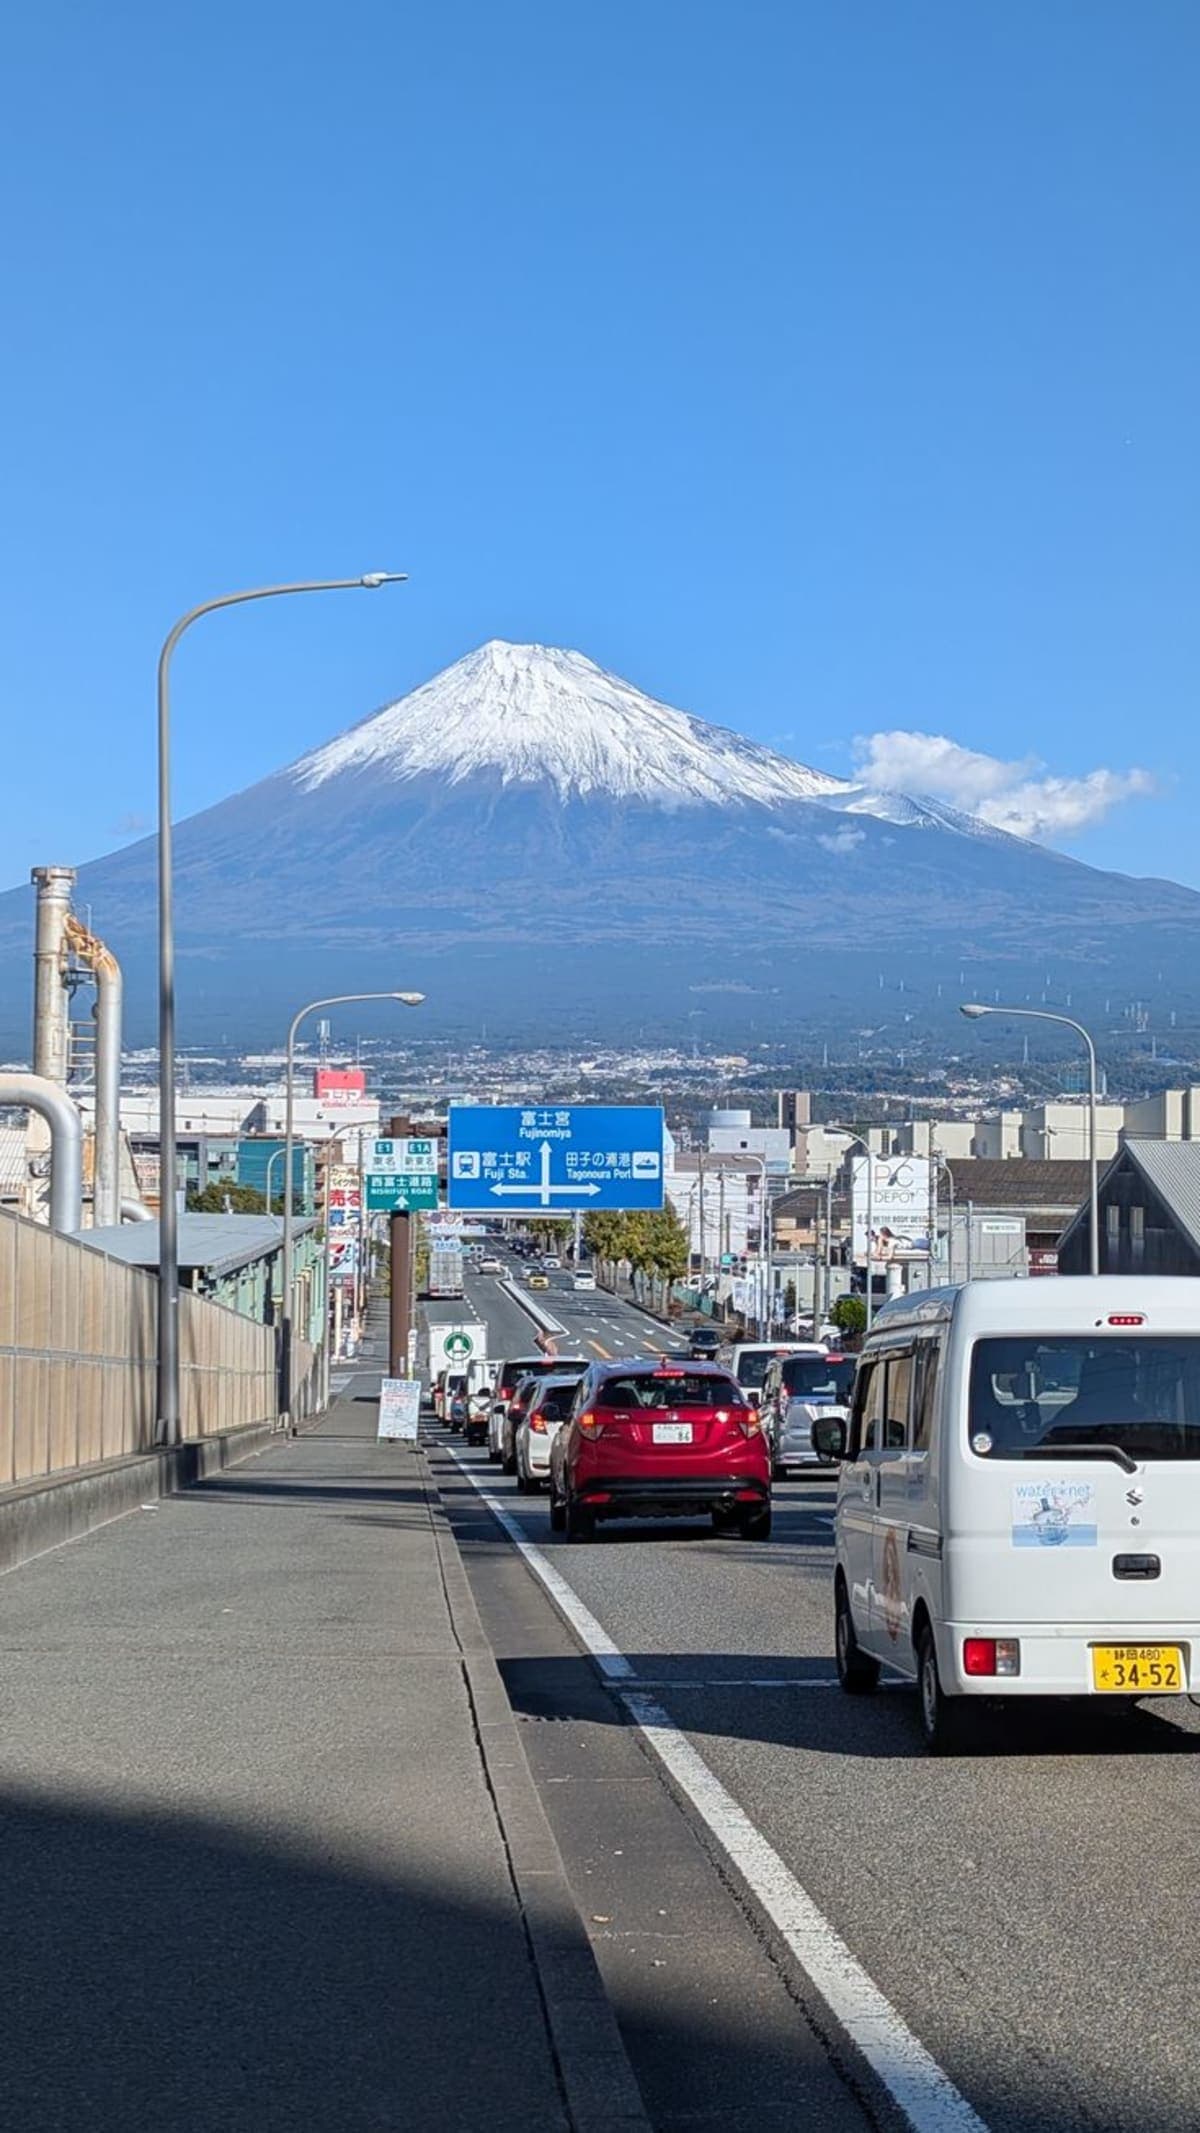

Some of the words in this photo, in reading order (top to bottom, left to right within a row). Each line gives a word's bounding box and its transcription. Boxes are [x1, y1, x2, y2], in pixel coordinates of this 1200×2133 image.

[520, 1110, 571, 1126] 富士宮
[518, 1127, 572, 1140] Fujinomiya
[377, 1143, 391, 1153] E1
[409, 1143, 430, 1153] E1A
[373, 1156, 396, 1166] 東名
[481, 1151, 532, 1167] 富士駅
[565, 1151, 631, 1167] 田子の浦港
[371, 1175, 433, 1188] 西富士道路
[483, 1168, 505, 1182] Fuji
[507, 1168, 529, 1180] Sta.
[566, 1168, 612, 1182] Tagonoura
[613, 1168, 632, 1180] Port
[329, 1188, 360, 1207] 売る
[410, 1187, 433, 1195] ROAD
[874, 1191, 915, 1204] DEPOT
[1113, 1663, 1178, 1686] 34-52
